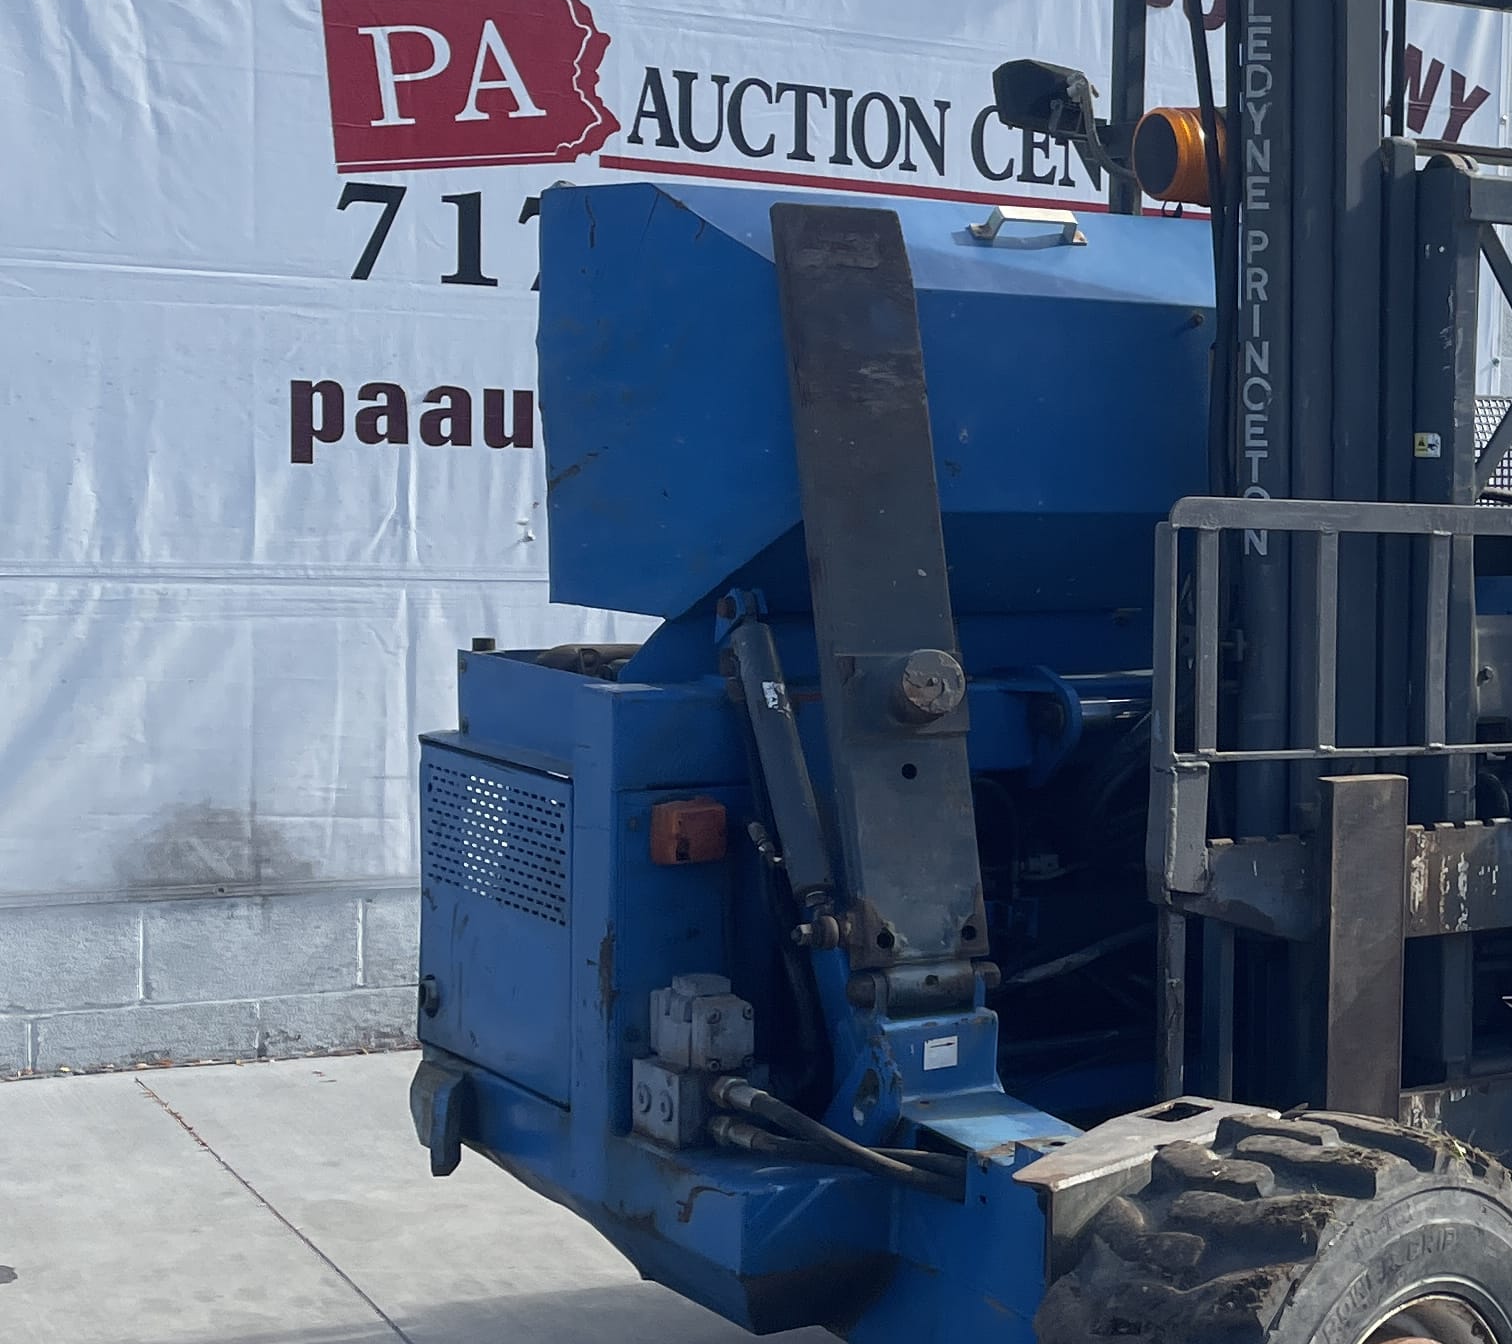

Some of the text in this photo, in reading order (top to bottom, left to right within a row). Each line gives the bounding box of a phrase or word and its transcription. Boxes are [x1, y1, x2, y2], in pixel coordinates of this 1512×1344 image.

[357, 18, 548, 128] PA
[627, 66, 951, 177] AUCTION
[336, 182, 541, 292] 71
